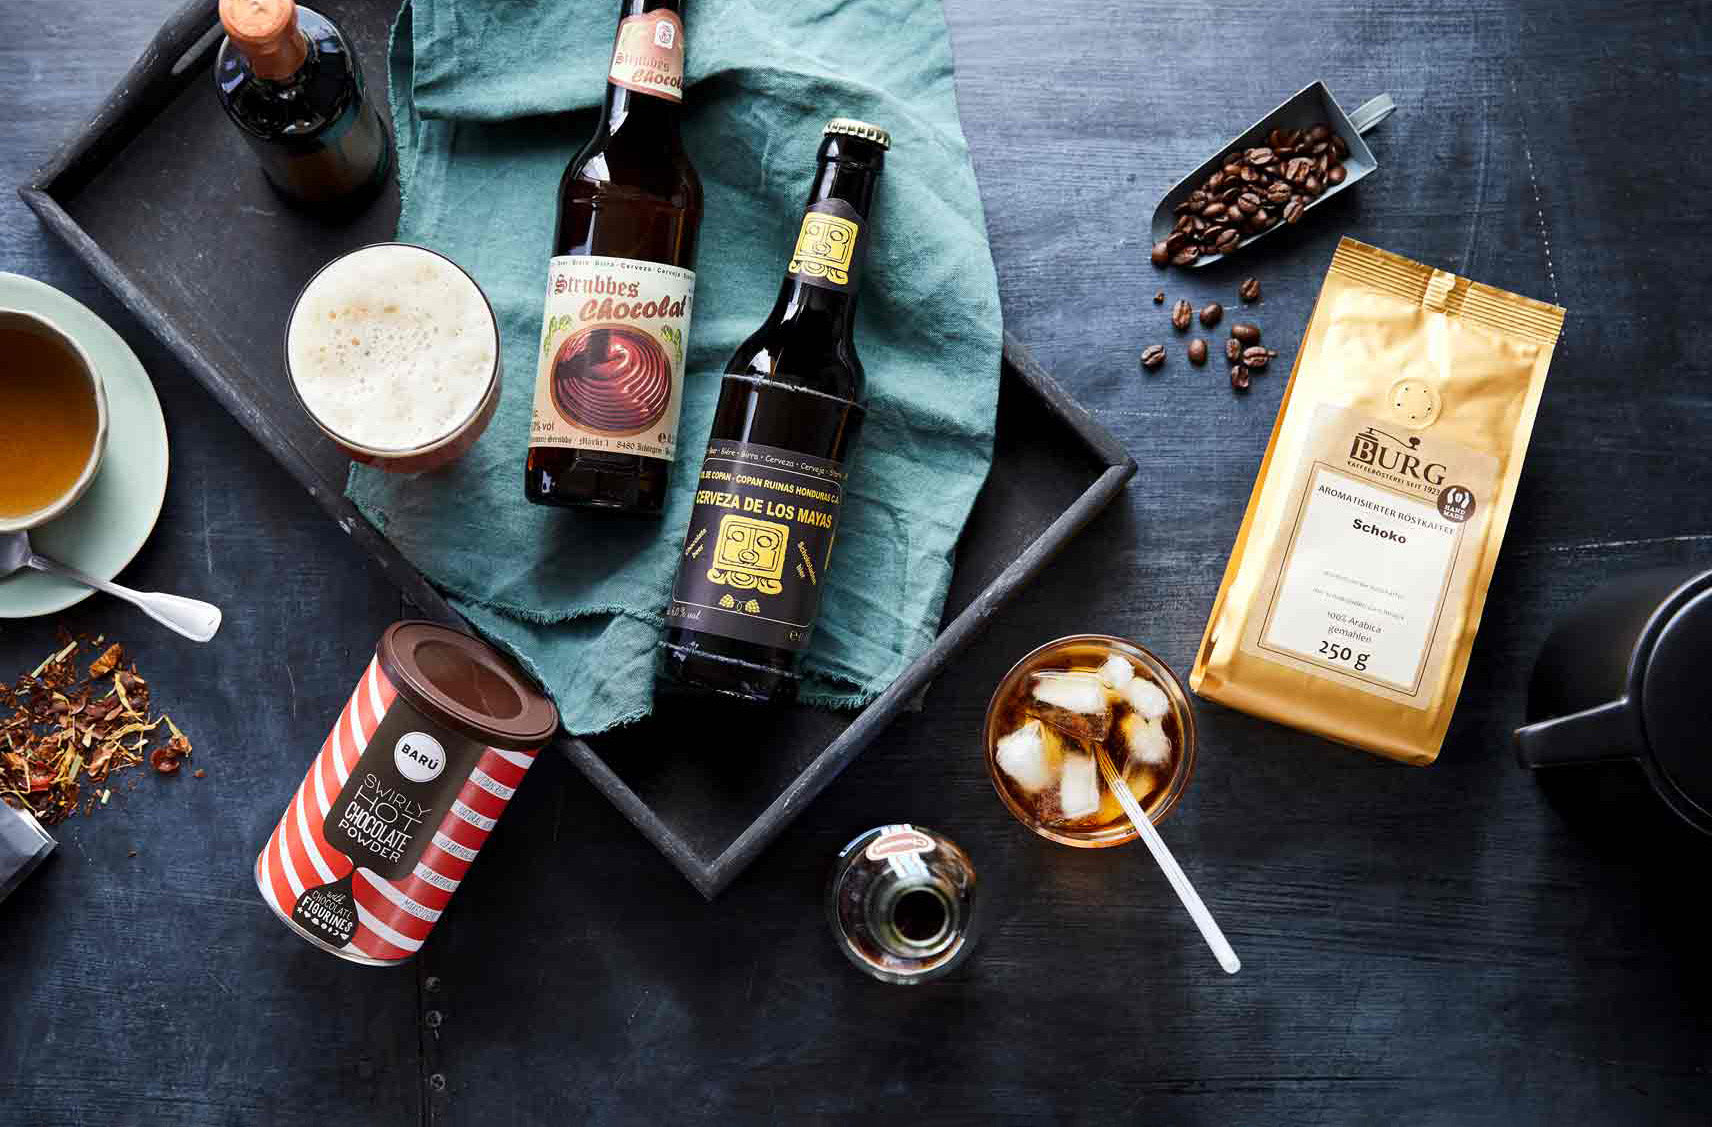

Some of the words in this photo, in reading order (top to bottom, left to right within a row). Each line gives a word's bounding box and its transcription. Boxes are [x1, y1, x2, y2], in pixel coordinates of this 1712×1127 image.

[554, 273, 640, 298] Strubbes
[579, 294, 687, 322] Chocolat
[765, 455, 794, 467] Cerveza
[1350, 434, 1447, 487] BURG
[736, 474, 762, 487] COPAN
[762, 480, 795, 494] RUINAS
[796, 486, 831, 502] HONDURAS
[1406, 478, 1422, 490] SEIT
[696, 490, 740, 510] CERVEZA
[743, 496, 764, 513] DE
[766, 501, 795, 520] LOS
[797, 507, 833, 529] MAYAS
[1318, 484, 1396, 518] AROMATISIERTER
[1352, 518, 1408, 544] Schoko
[1327, 625, 1373, 644] gemahlen
[1349, 617, 1382, 634] Arabica
[1319, 640, 1352, 661] 250
[1354, 652, 1371, 672] g
[401, 743, 439, 771] BARÚ
[354, 784, 423, 832] HOT
[364, 773, 433, 818] SWIRLY
[338, 819, 401, 863] POWDER
[344, 801, 413, 852] CHOCOLATE
[302, 895, 353, 933] FIGURINES
[311, 890, 353, 921] CHOCOLATE
